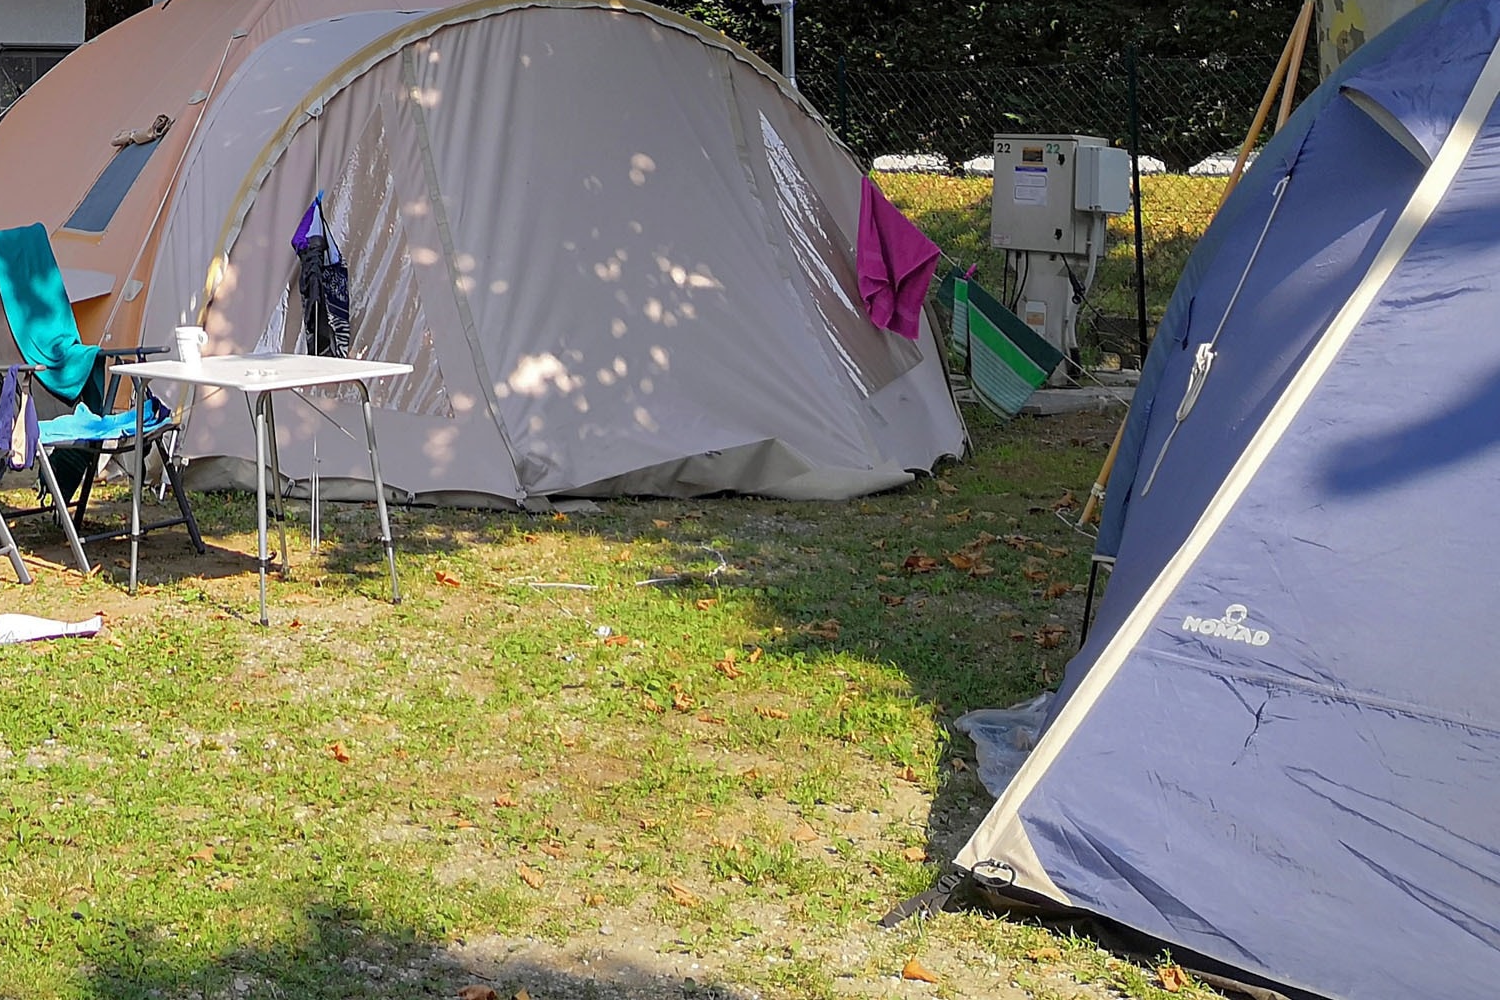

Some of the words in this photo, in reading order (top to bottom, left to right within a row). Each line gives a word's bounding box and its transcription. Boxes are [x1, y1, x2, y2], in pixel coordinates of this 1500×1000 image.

[997, 143, 1011, 153] 22
[1046, 143, 1060, 154] 22
[1182, 615, 1270, 646] NOMAD
